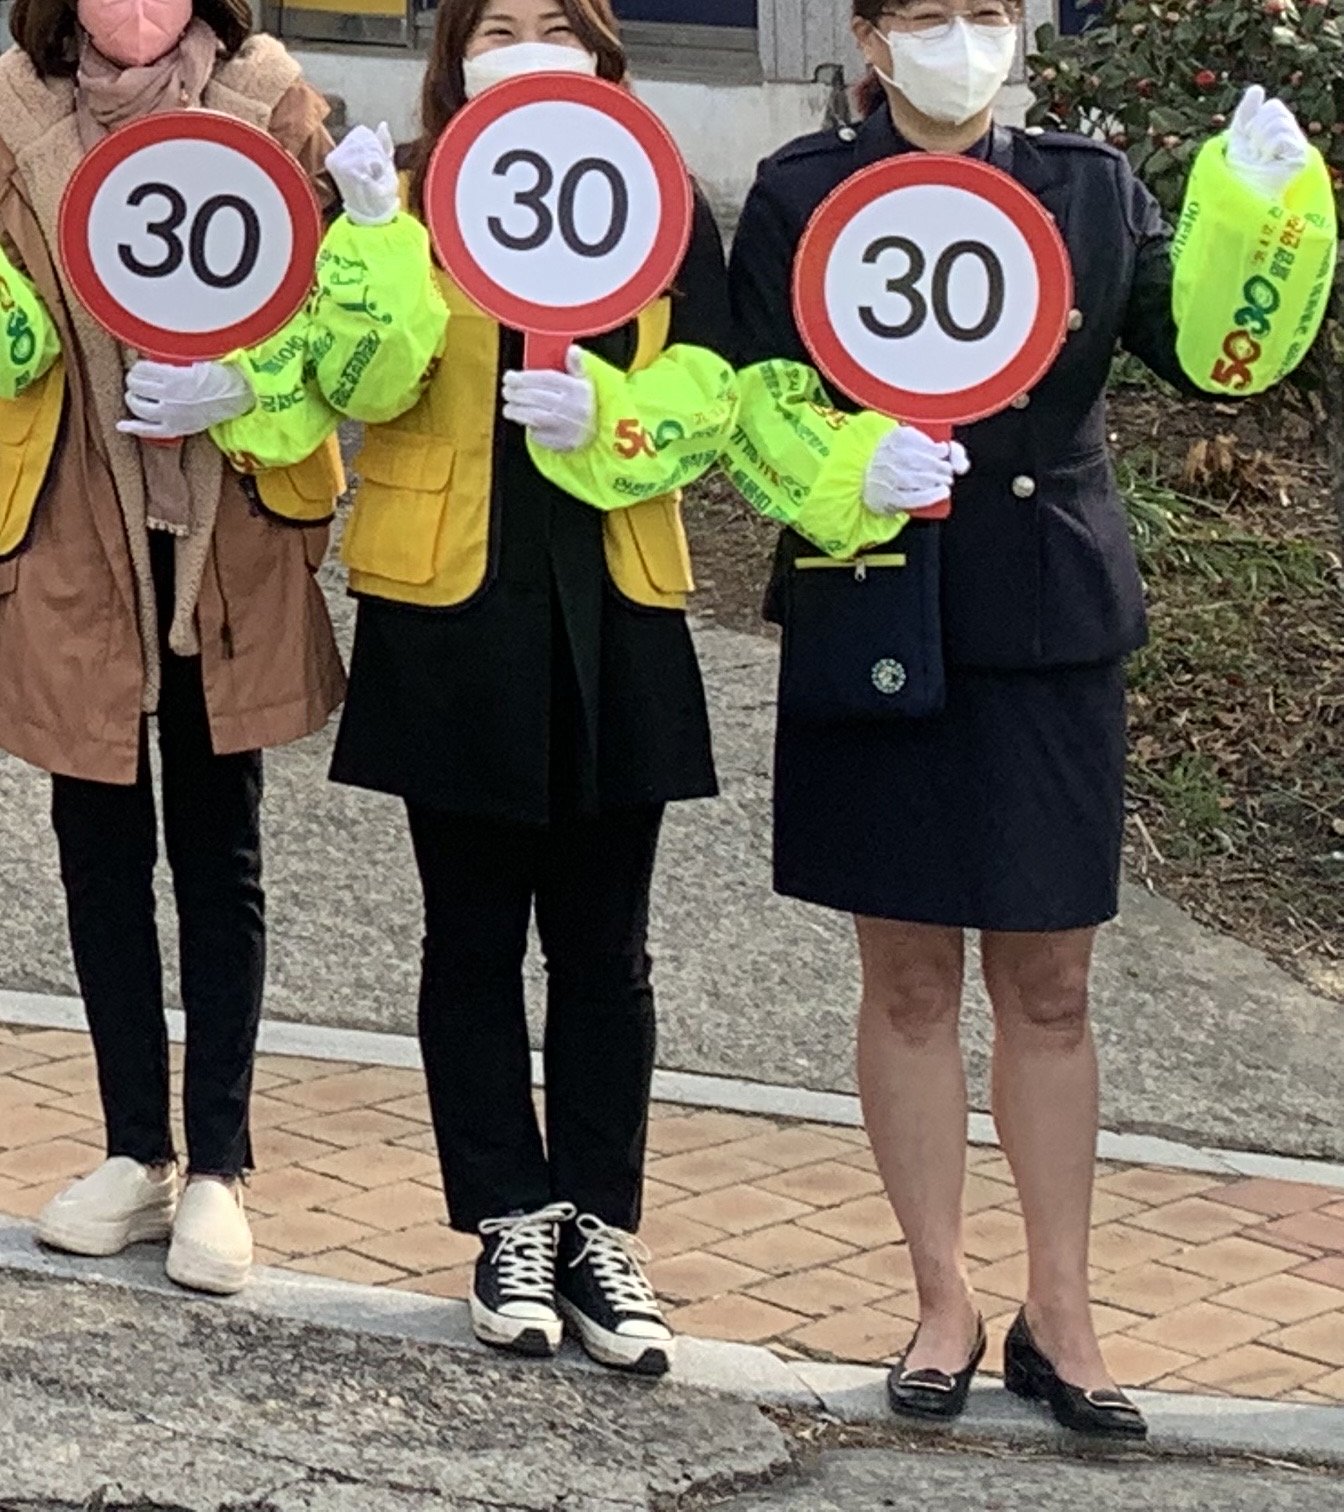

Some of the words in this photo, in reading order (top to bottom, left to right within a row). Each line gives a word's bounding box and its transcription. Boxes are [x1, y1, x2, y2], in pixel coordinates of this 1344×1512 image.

[116, 181, 262, 290] 30
[487, 147, 630, 260] 30
[856, 235, 1006, 343] 30
[1210, 274, 1281, 390] 5030
